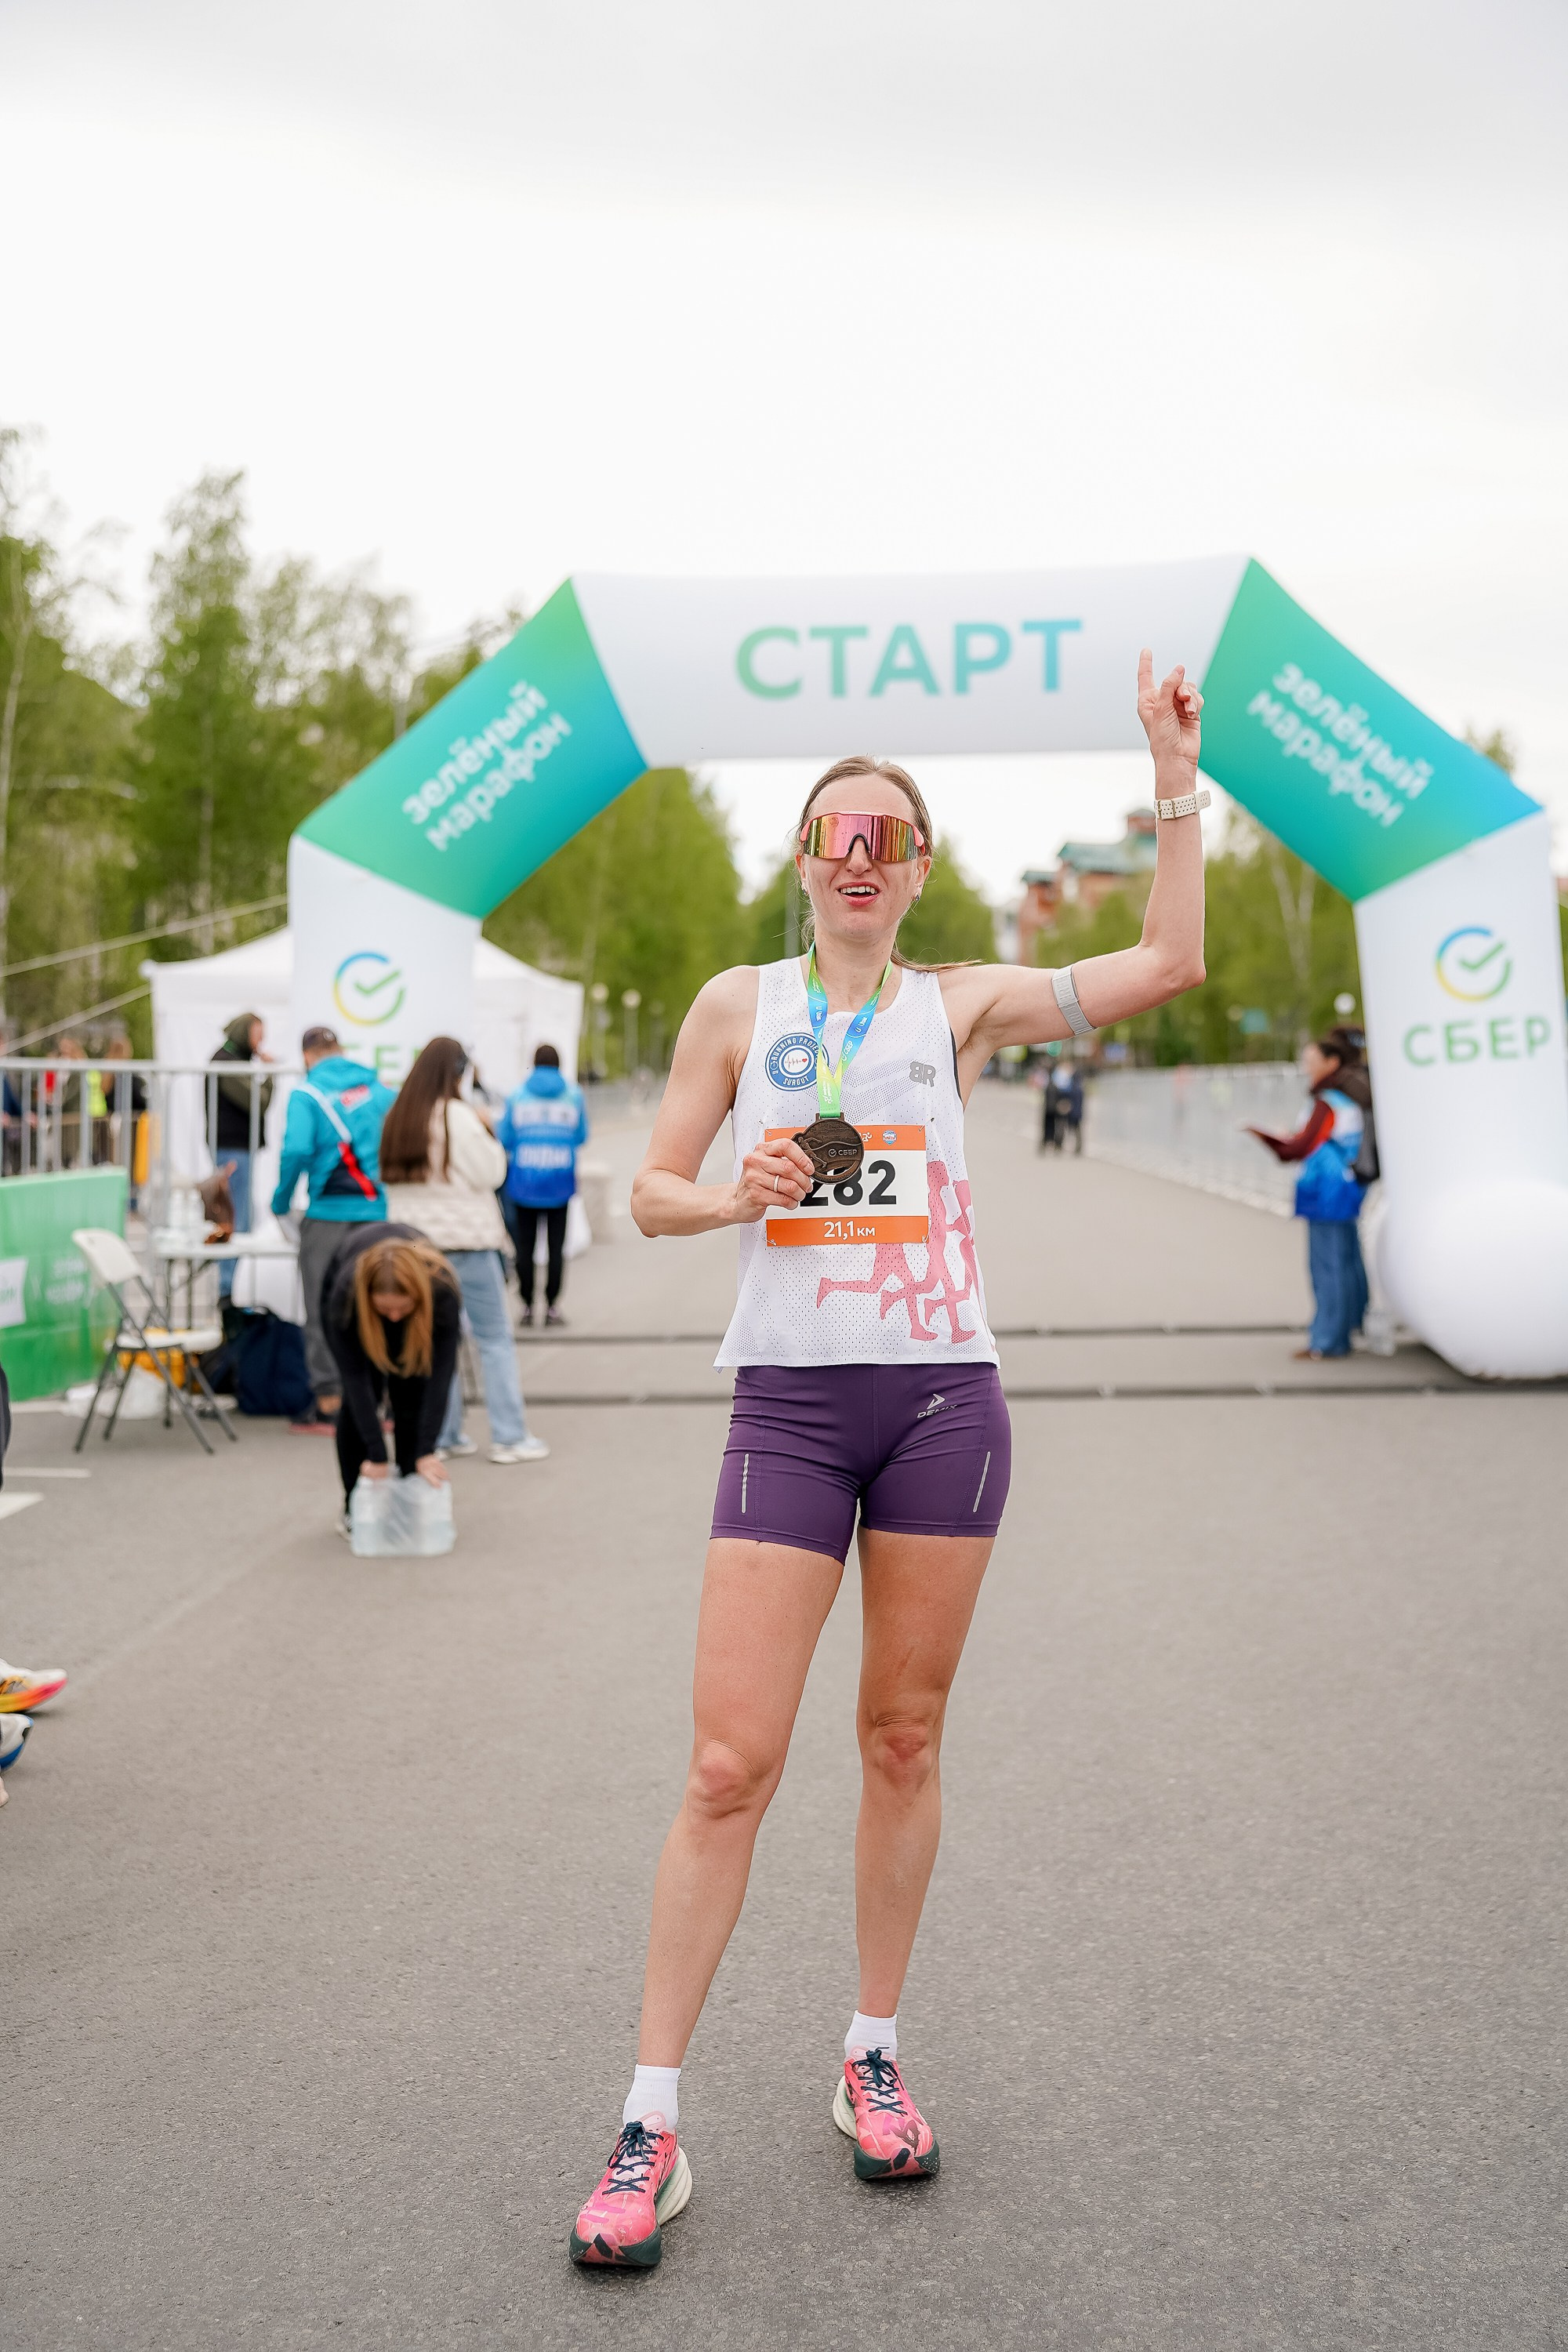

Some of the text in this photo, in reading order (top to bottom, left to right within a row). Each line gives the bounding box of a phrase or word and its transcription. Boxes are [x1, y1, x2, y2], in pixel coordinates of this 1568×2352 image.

[735, 619, 1083, 701] СТАРТ
[425, 712, 572, 851] марафон
[1247, 690, 1405, 828] марафон
[771, 1037, 818, 1061] RUNNING PROJEC
[1403, 1014, 1552, 1068] СБЕР
[782, 1076, 809, 1086] SURGUT
[824, 1221, 855, 1240] 21,1
